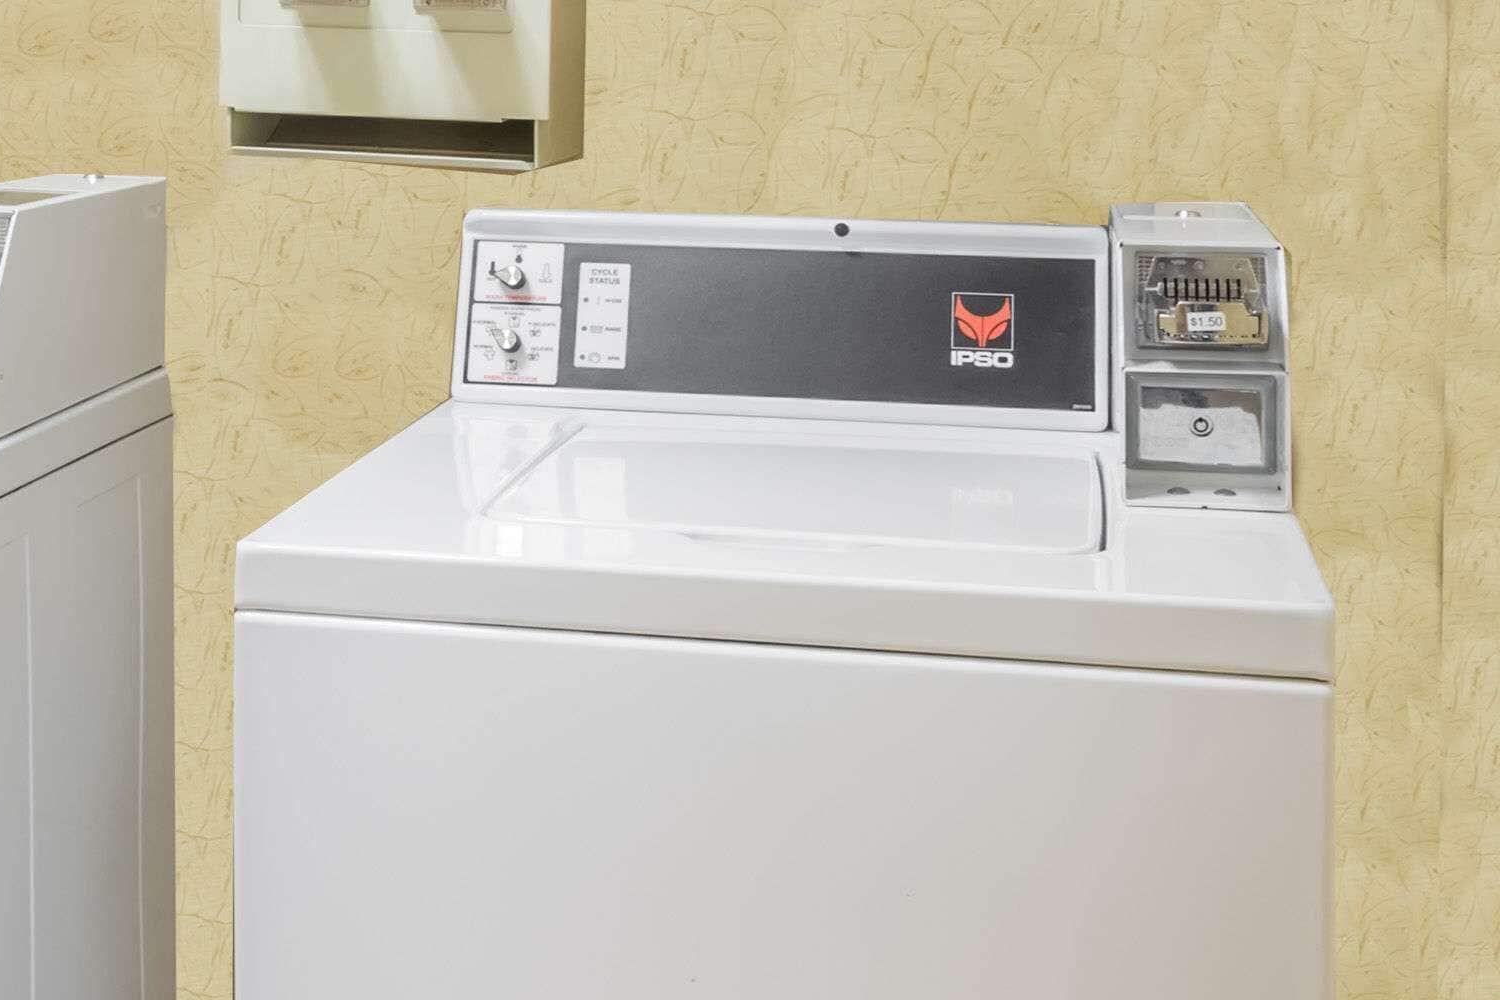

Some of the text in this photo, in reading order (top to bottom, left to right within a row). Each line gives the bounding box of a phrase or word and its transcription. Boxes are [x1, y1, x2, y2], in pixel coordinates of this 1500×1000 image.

[591, 268, 619, 277] CYCLE
[588, 277, 621, 285] STATUS
[1190, 316, 1223, 328] $1.50
[950, 350, 1014, 369] IPSO
